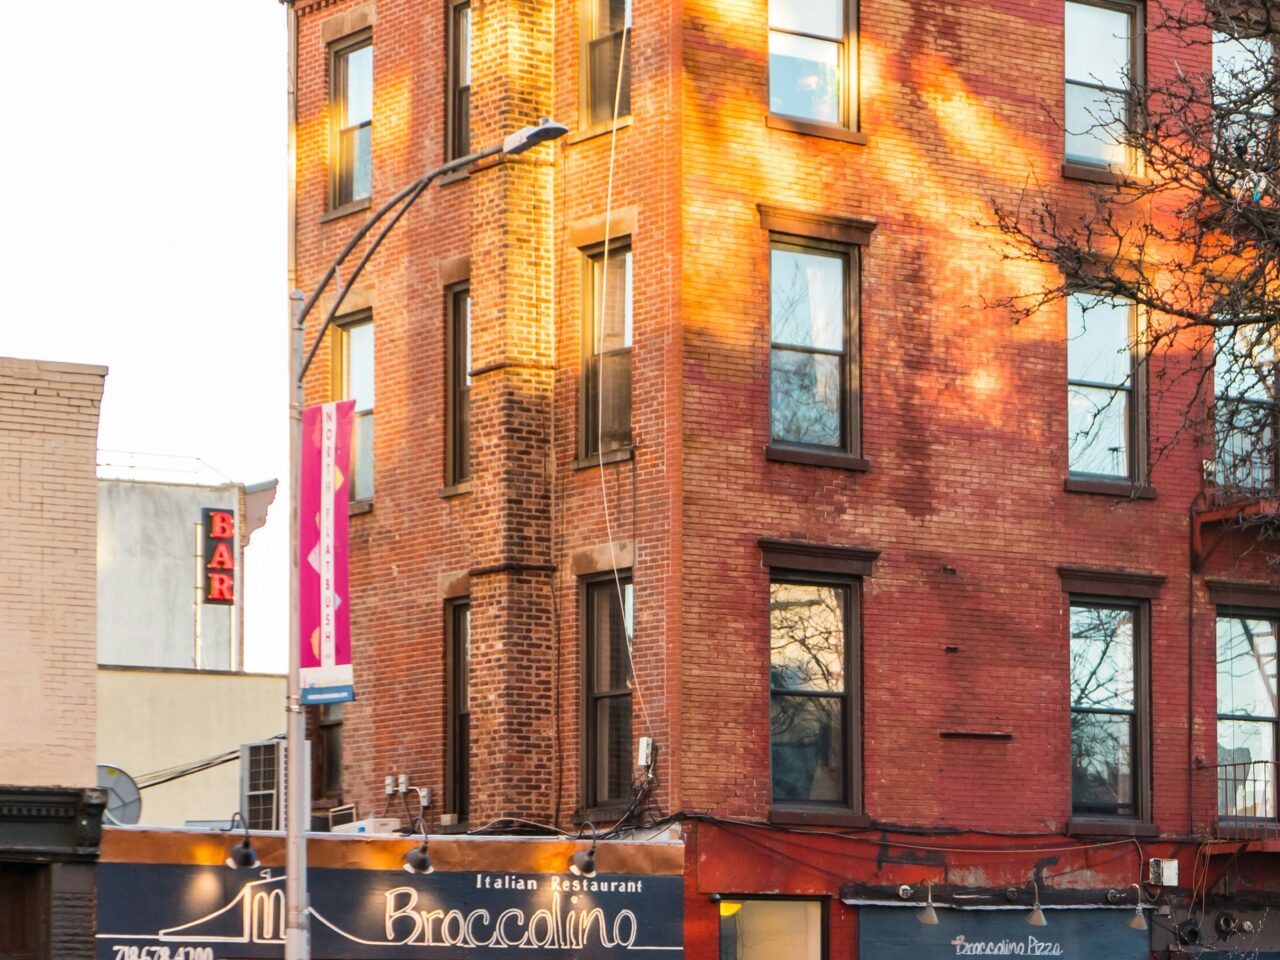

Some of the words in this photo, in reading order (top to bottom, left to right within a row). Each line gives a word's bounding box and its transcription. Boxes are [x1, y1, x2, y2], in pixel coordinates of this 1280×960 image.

[207, 511, 235, 601] BAR
[475, 873, 538, 890] Italian
[550, 875, 643, 893] Restaurant
[384, 886, 638, 949] Broccolino
[955, 934, 1025, 956] Broccolino
[1027, 935, 1064, 956] Pizza
